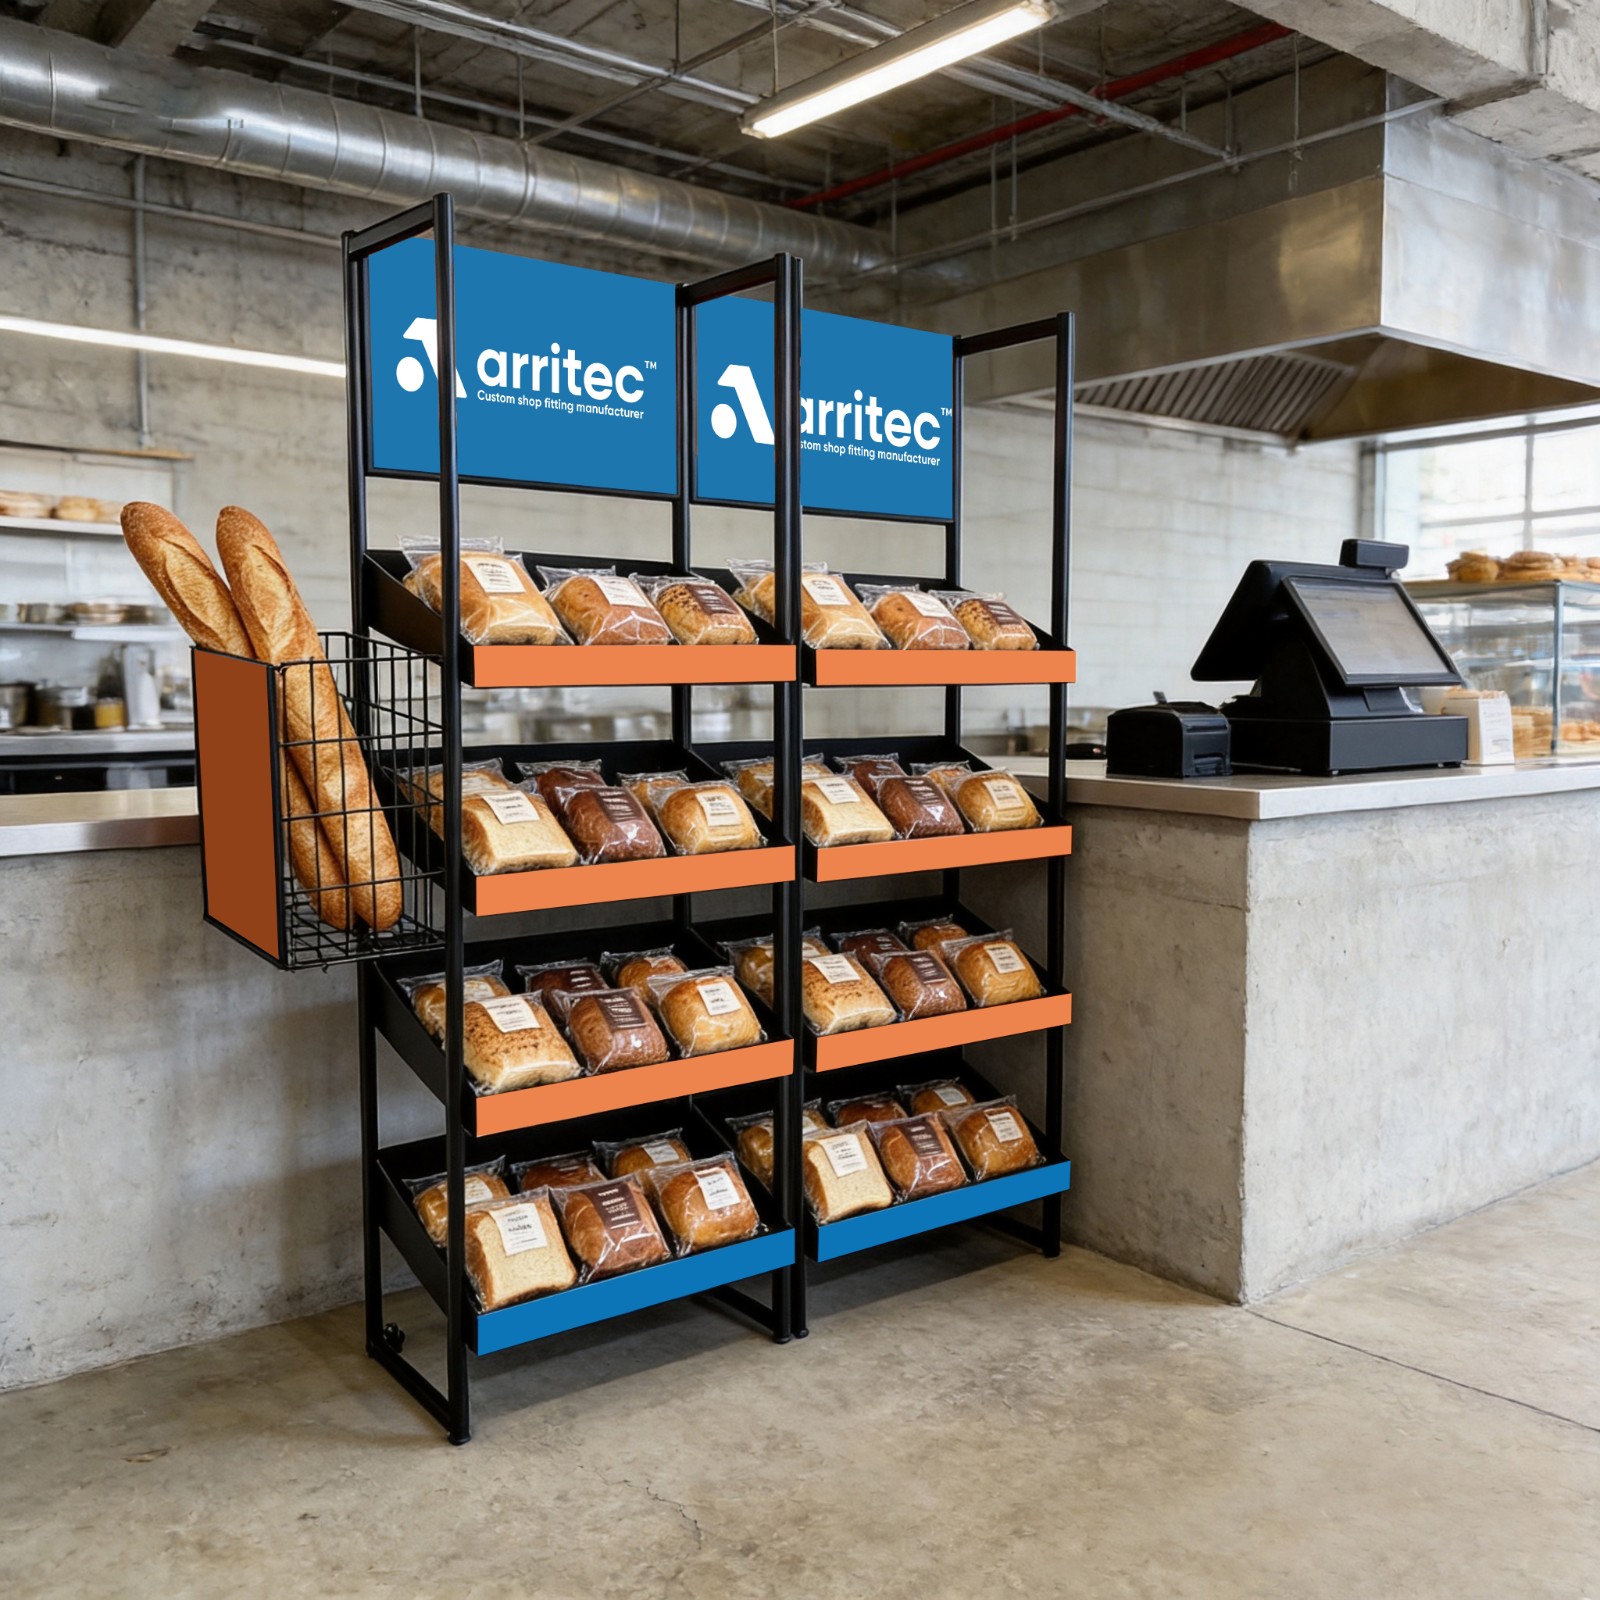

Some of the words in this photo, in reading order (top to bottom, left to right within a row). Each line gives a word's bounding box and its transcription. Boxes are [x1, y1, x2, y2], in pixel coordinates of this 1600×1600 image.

[477, 389, 516, 405] Custom
[517, 394, 542, 410] shop
[544, 397, 574, 414] fitting
[576, 404, 644, 420] manufacturer
[823, 441, 846, 456] shop
[848, 444, 876, 461] fitting
[877, 450, 941, 467] manufacturer
